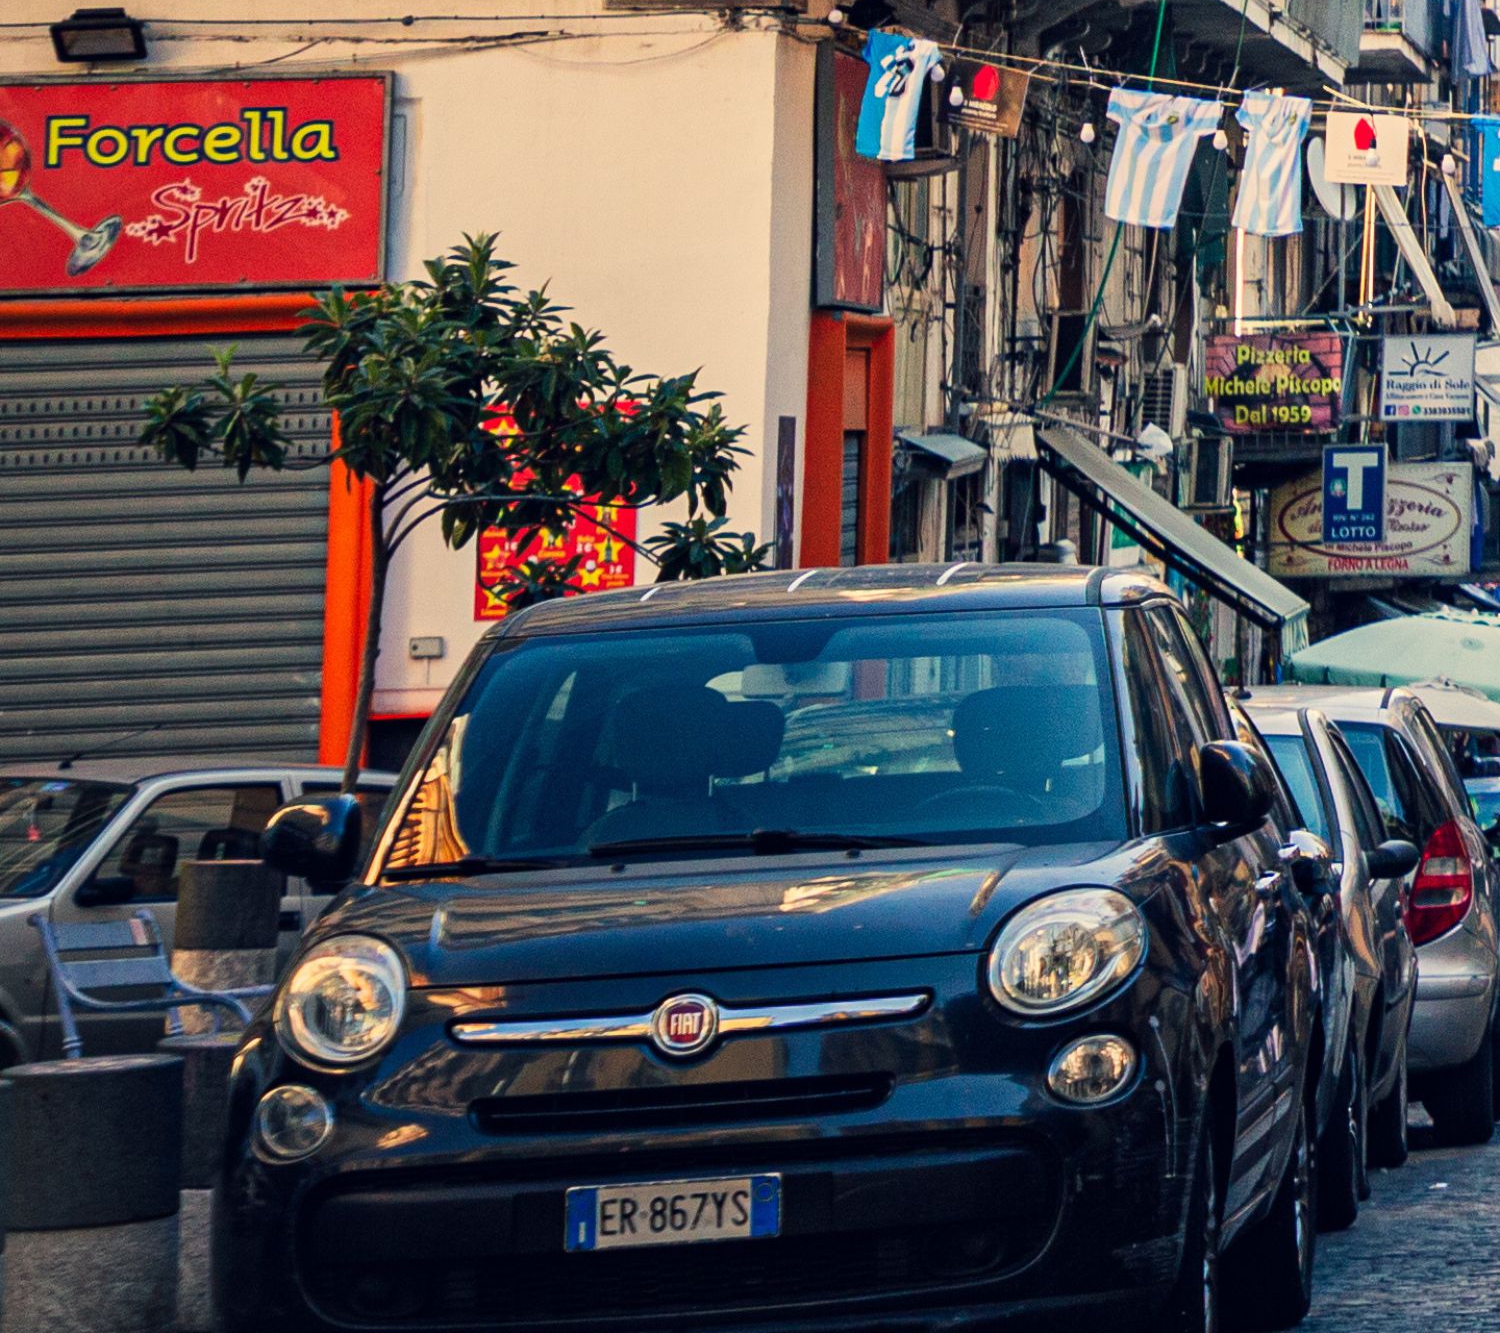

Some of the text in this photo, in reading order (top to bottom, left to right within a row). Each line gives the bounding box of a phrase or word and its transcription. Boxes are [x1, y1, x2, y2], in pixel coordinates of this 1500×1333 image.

[46, 107, 339, 168] Forcella
[150, 178, 308, 263] Spritz
[1236, 343, 1311, 367] Pizzeria
[1204, 373, 1342, 397] Michele Piscopo
[1444, 379, 1470, 390] Sole
[1234, 404, 1312, 425] Dal 1959
[1332, 452, 1379, 510] T
[1331, 525, 1376, 539] LOTTO
[1327, 558, 1365, 571] FORNO
[1374, 558, 1409, 571] LEGNA
[669, 1011, 702, 1036] FIAT
[600, 1189, 750, 1236] ER 867YS
